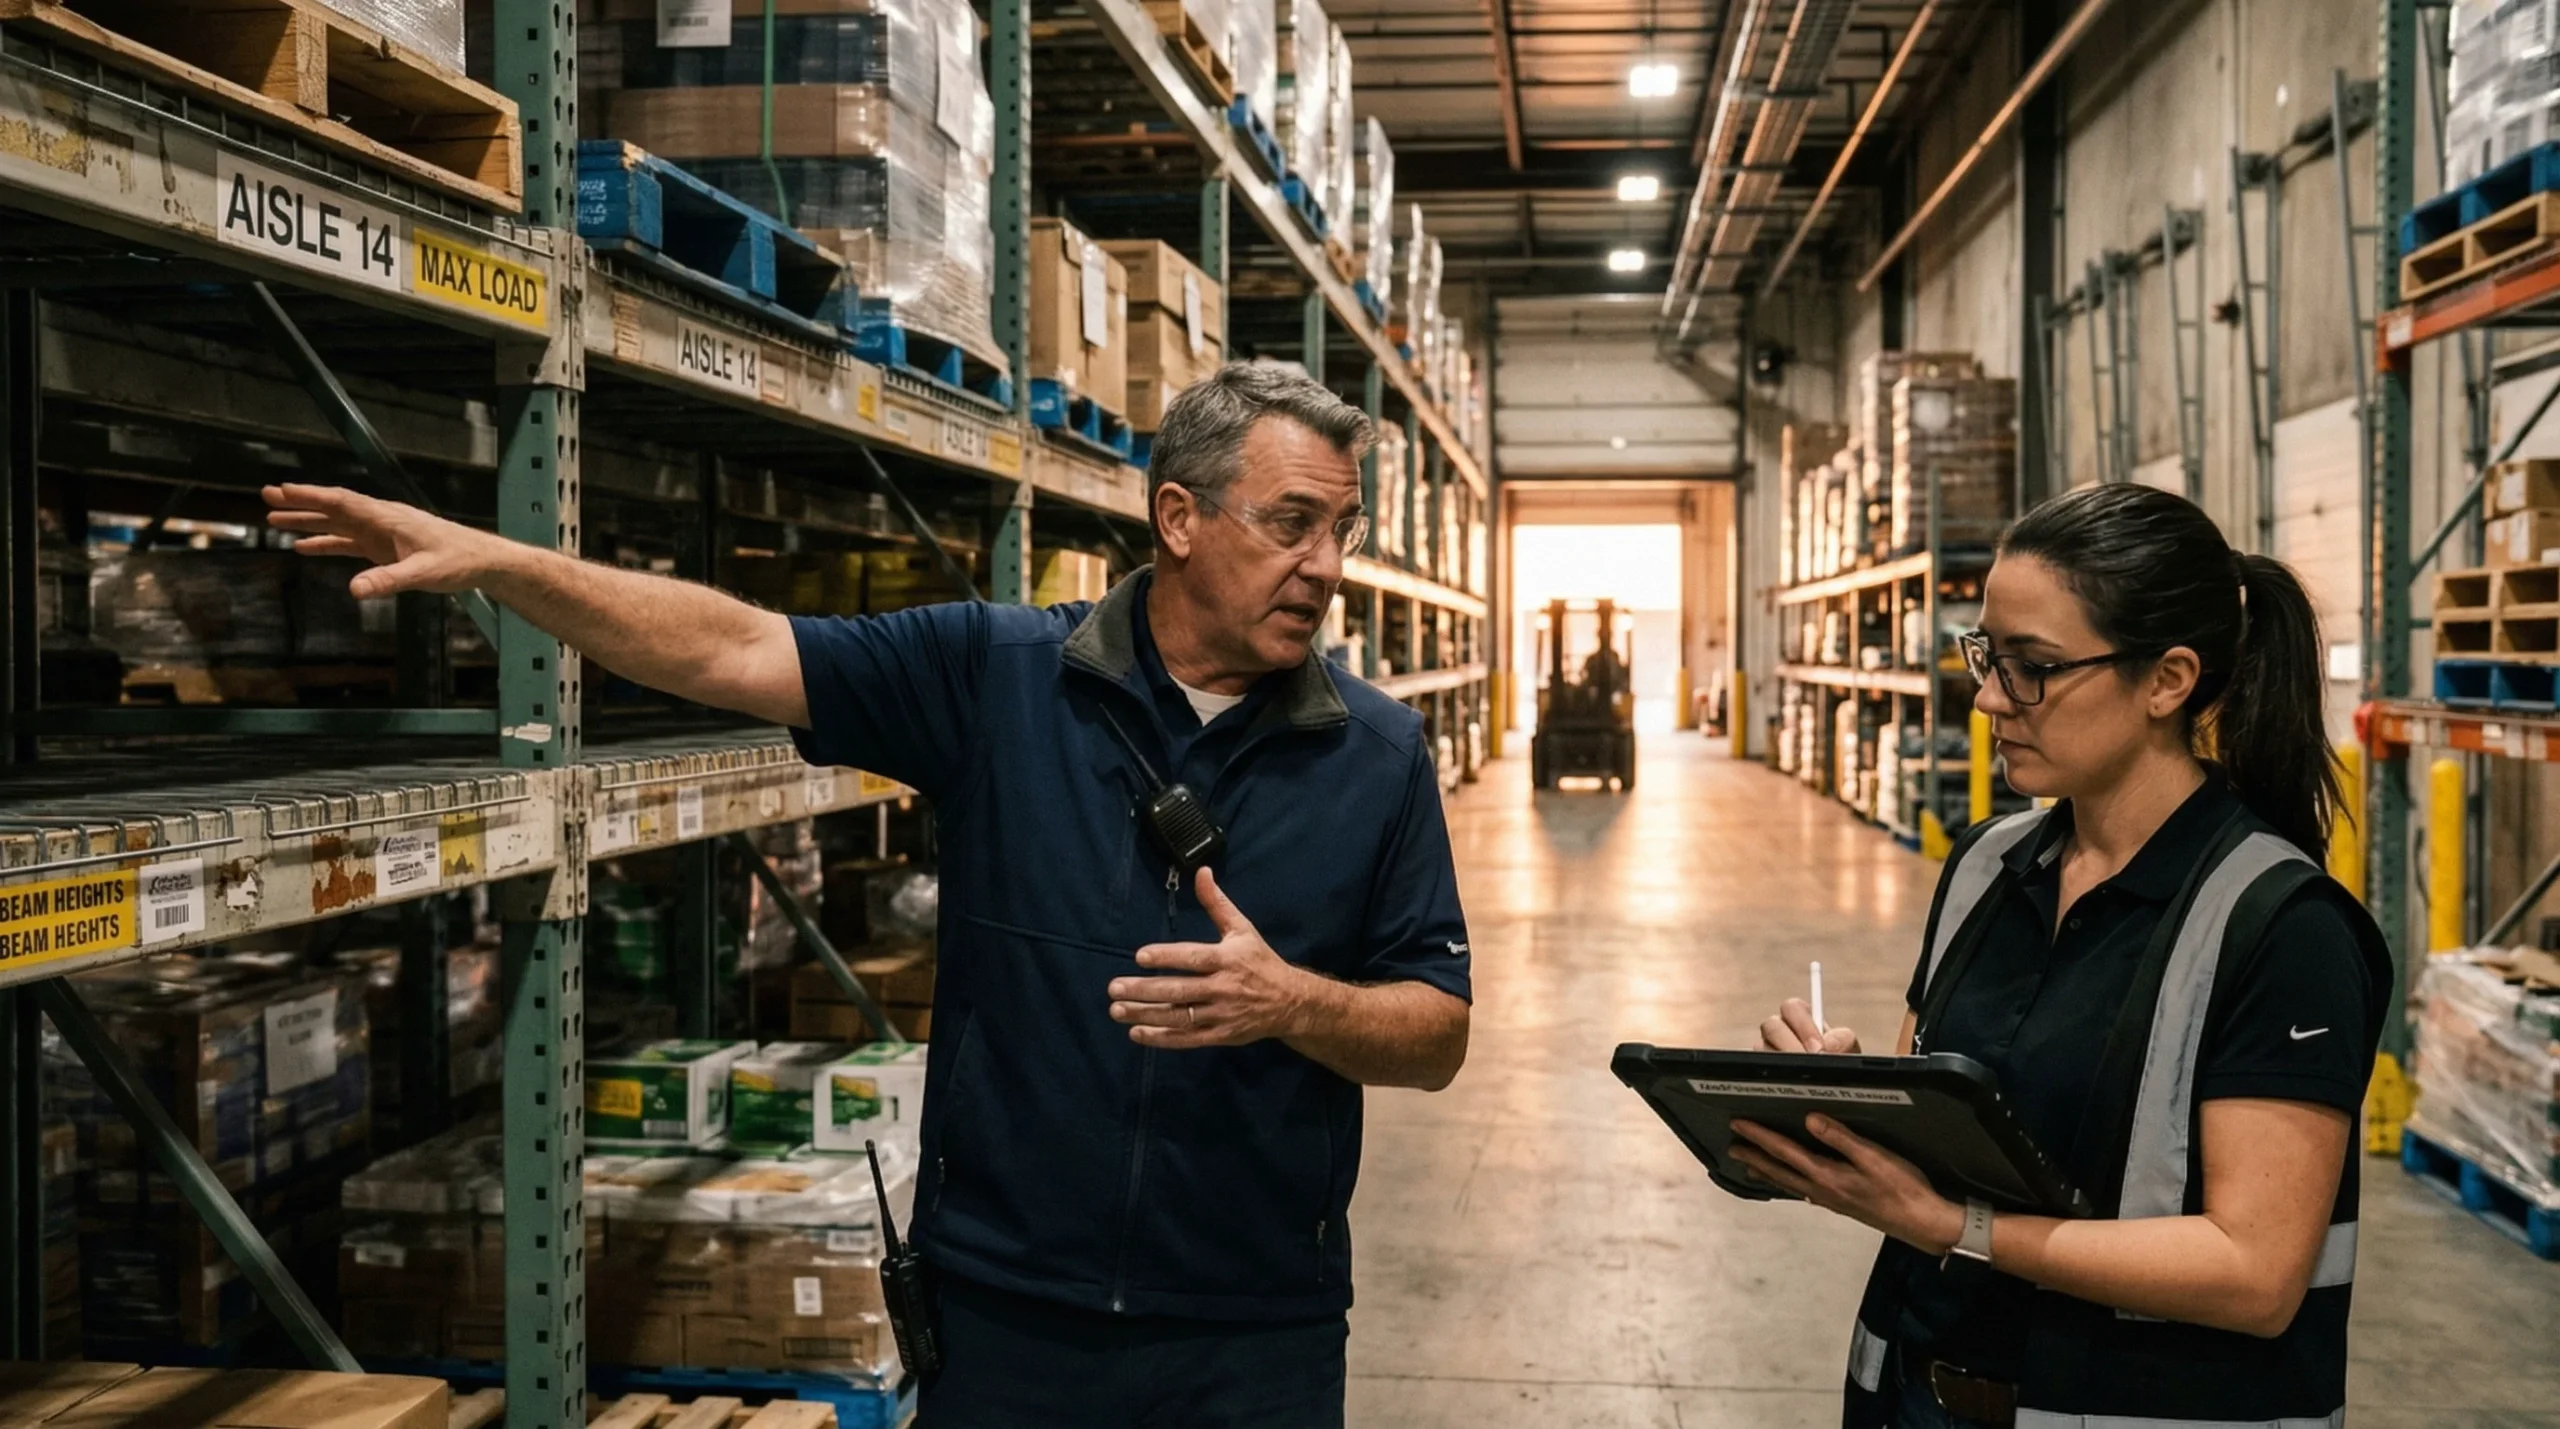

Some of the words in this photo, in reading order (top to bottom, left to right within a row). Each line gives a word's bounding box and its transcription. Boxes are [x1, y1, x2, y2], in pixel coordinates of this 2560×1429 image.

[225, 172, 341, 262] AISLE
[355, 215, 394, 277] 14
[421, 242, 472, 296] MAX
[479, 261, 538, 313] LOAD
[681, 328, 732, 380] AISLE
[739, 348, 756, 388] 14
[0, 890, 48, 922] BEAM
[54, 879, 124, 913] HEIGHTS
[0, 927, 48, 960] BEAM
[55, 914, 119, 949] HEGHTS
